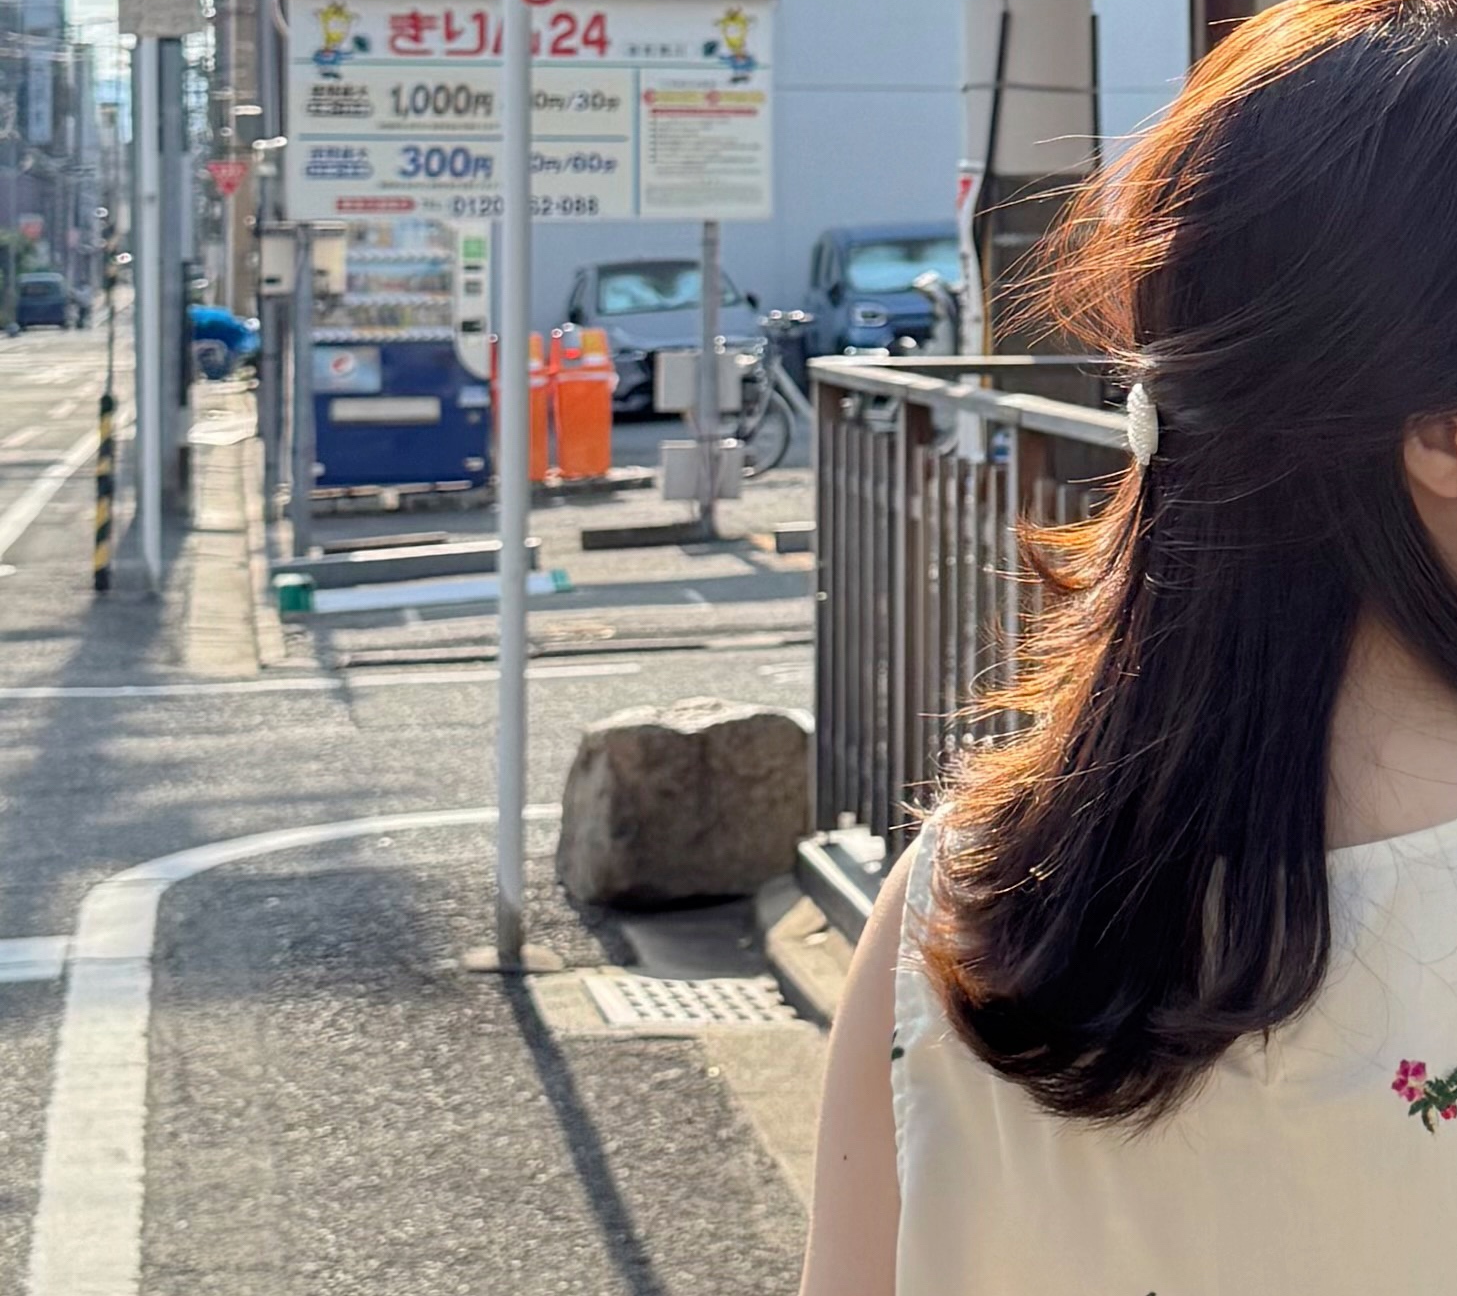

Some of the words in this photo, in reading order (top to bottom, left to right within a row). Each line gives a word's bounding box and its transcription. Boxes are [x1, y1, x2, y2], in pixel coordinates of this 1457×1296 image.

[388, 9, 611, 56] きり24
[391, 82, 493, 119] 1,000円
[400, 145, 494, 180] 300円
